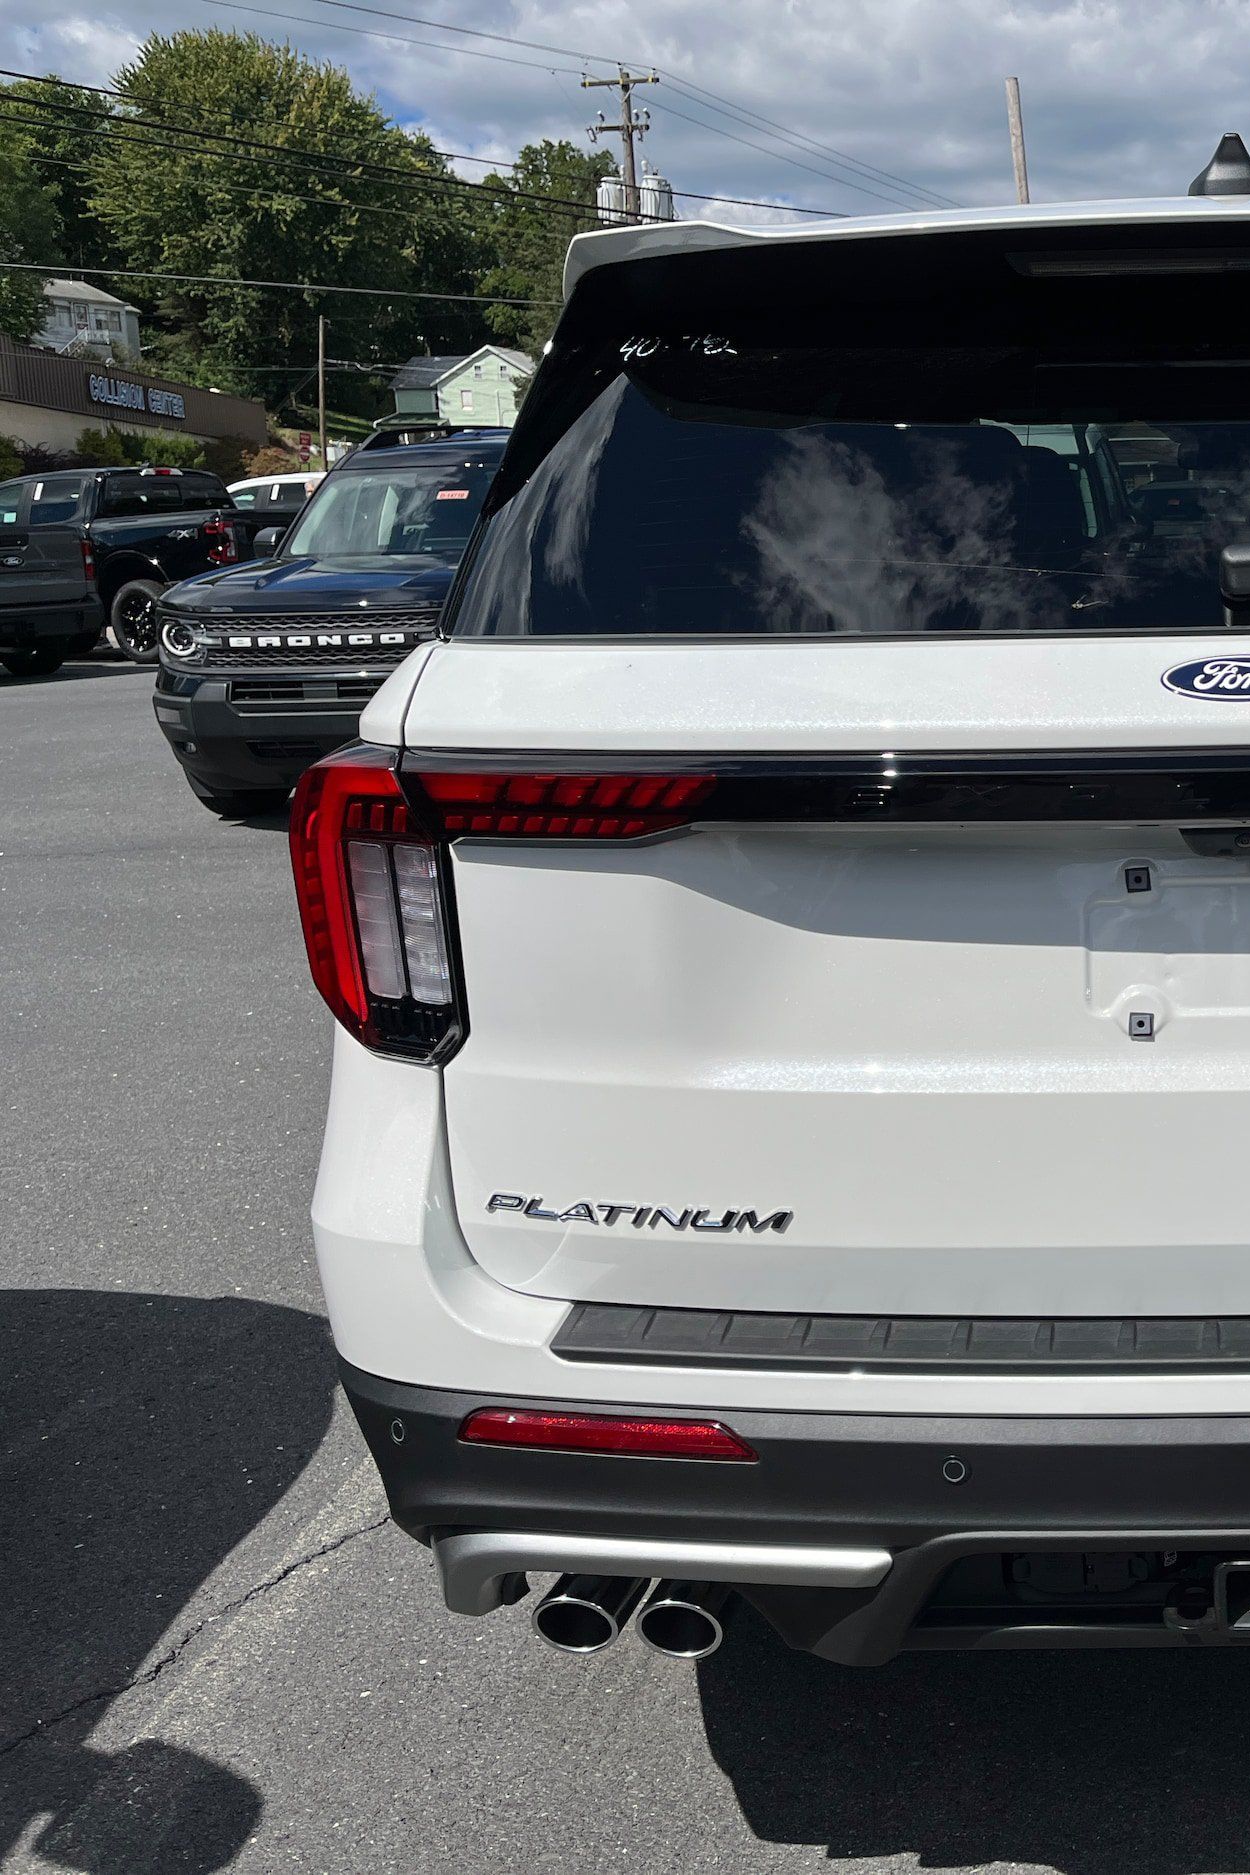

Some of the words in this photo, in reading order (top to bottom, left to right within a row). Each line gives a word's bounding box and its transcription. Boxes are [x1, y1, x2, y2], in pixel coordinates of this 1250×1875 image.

[89, 374, 145, 411] COLLISION
[147, 387, 186, 419] CENTER
[228, 633, 405, 648] BRONCO
[486, 1192, 794, 1234] PLATINUM
